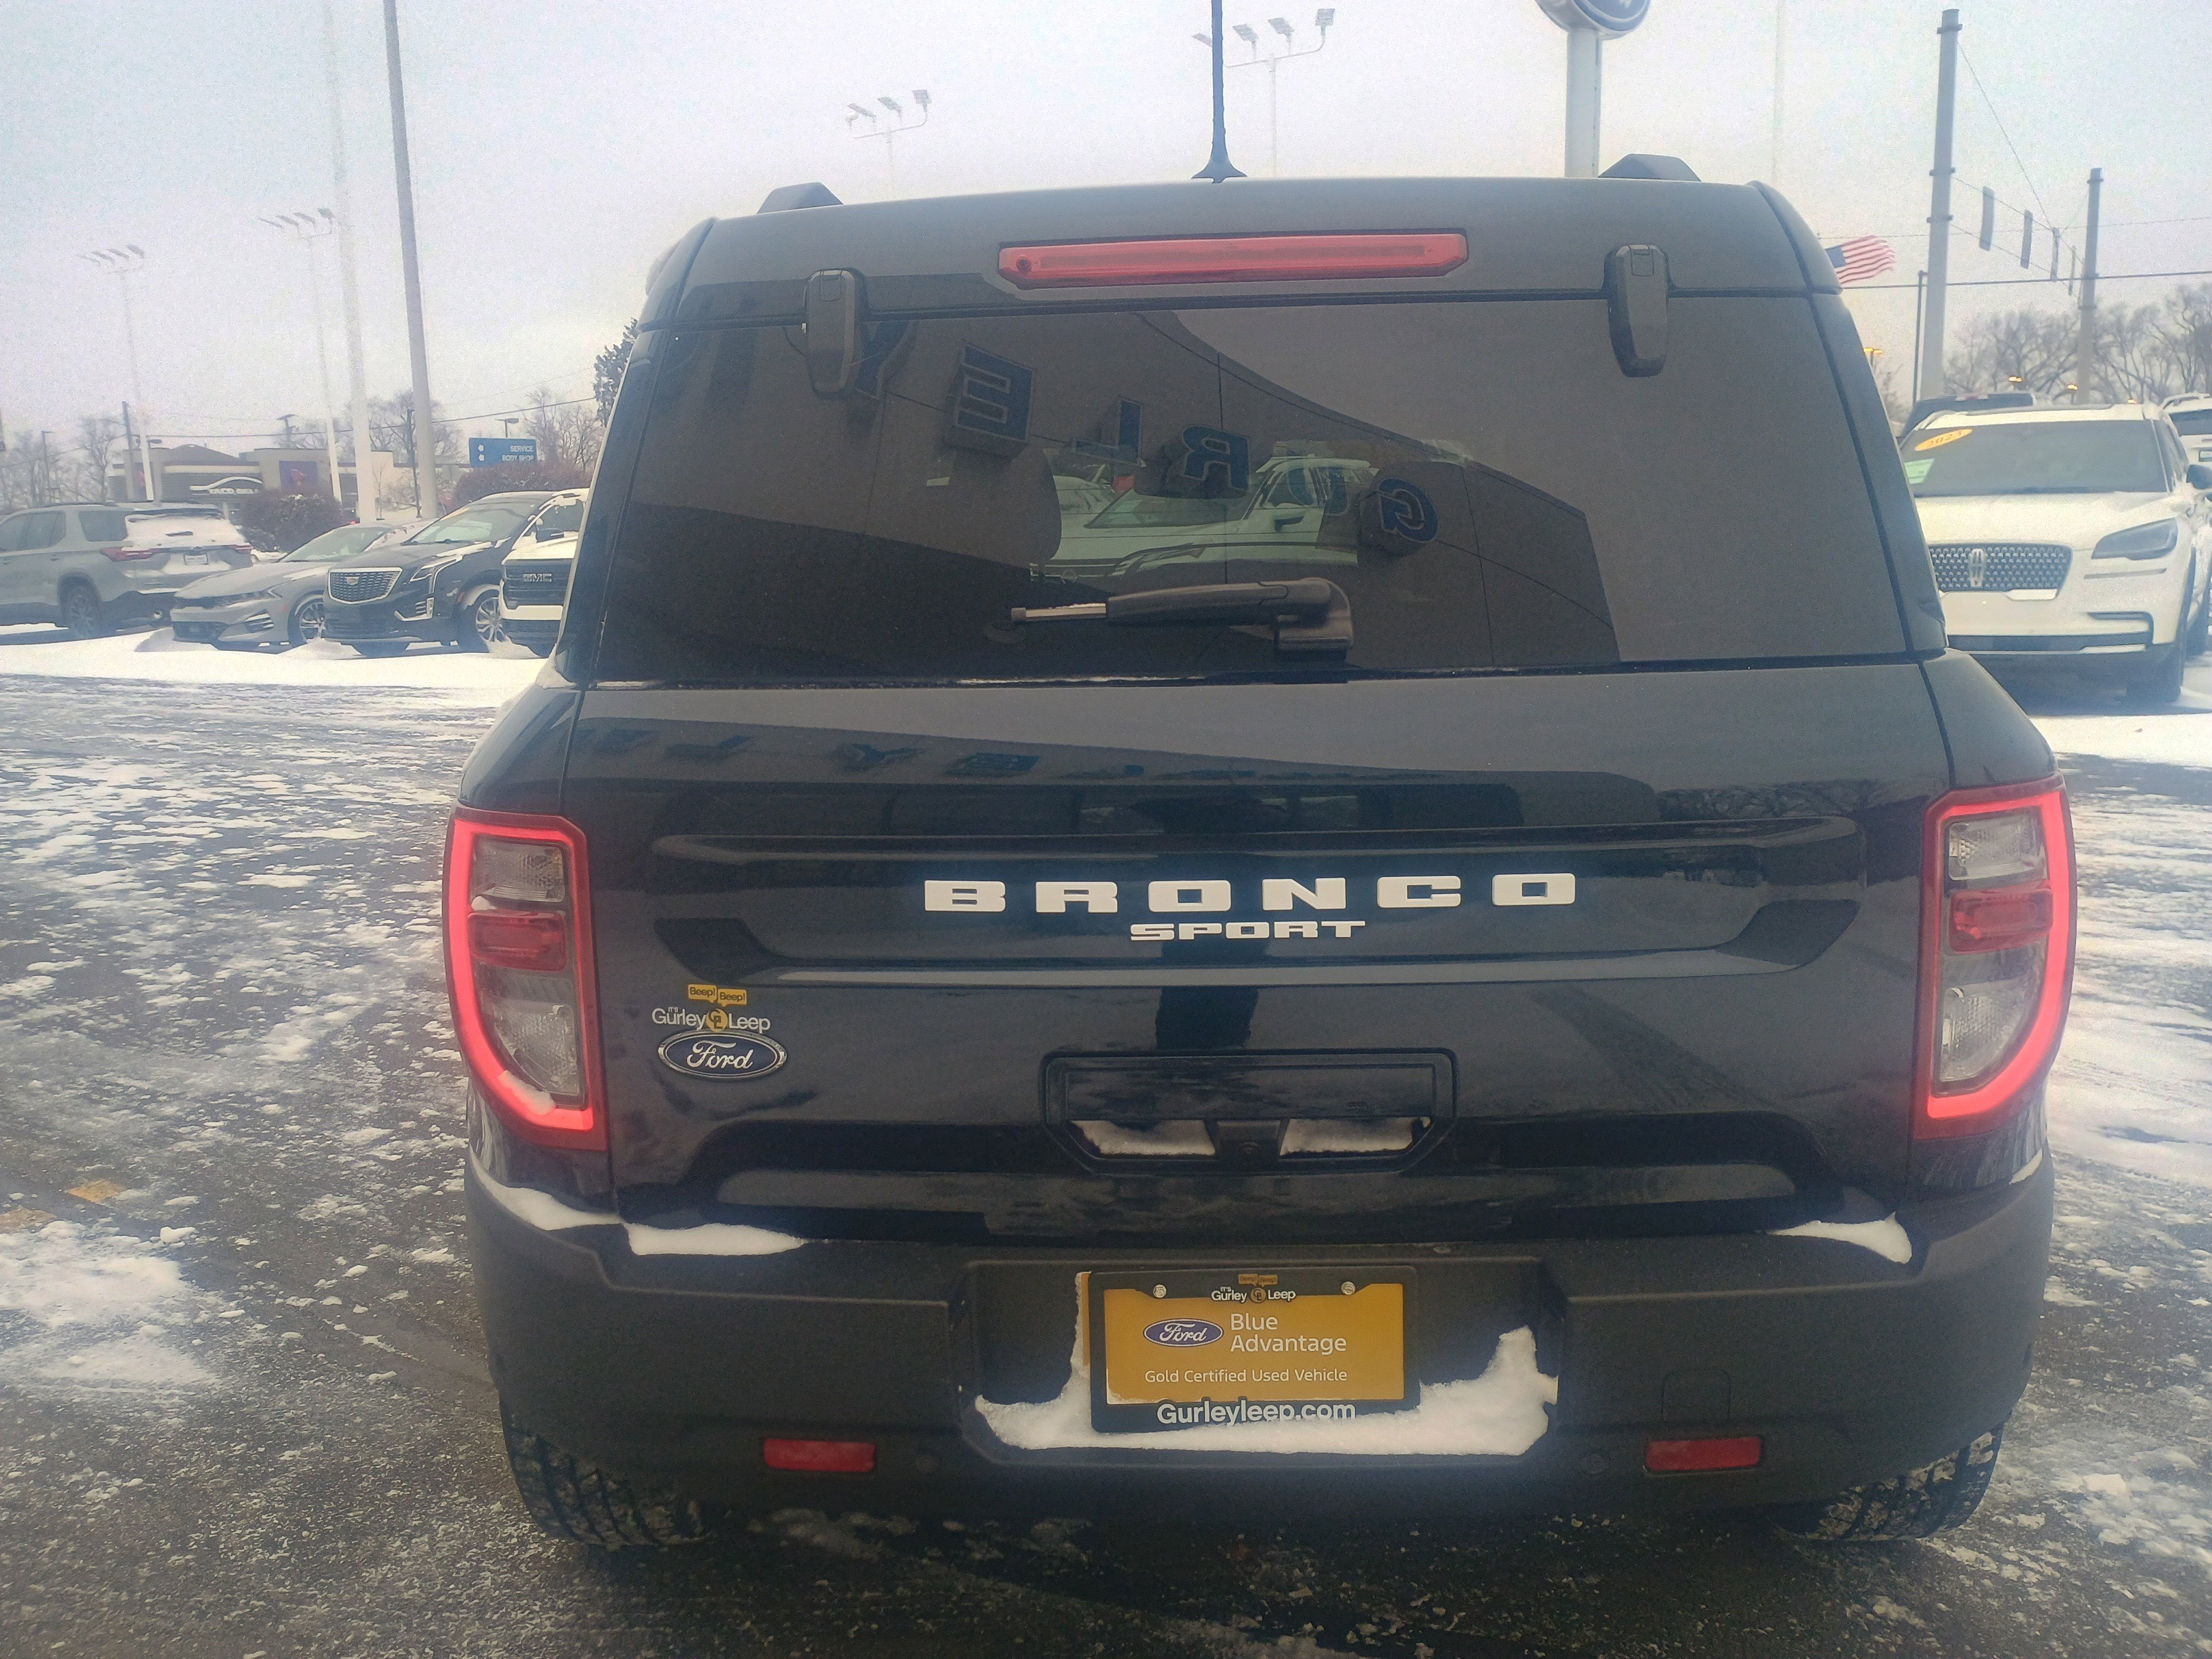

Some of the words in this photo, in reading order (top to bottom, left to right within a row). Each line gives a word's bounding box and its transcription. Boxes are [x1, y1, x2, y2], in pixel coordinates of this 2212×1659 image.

[522, 574, 552, 582] GMC
[924, 873, 1576, 913] BRONCO
[1130, 920, 1366, 941] SPORT
[689, 987, 716, 997] Beep!
[719, 992, 745, 1002] Beep!
[651, 1008, 706, 1031] Gurley
[729, 1013, 771, 1034] Leep
[686, 1040, 754, 1069] Ford
[1211, 1290, 1247, 1303] Gurley
[1267, 1290, 1297, 1301] Leep
[1159, 1322, 1208, 1342] Ford
[1230, 1313, 1278, 1331] Blue
[1230, 1334, 1347, 1355] Advantage
[1145, 1370, 1179, 1382] Gold
[1184, 1369, 1246, 1382] Certified
[1252, 1369, 1290, 1382] Used
[1294, 1368, 1347, 1381] Vehicle
[1157, 1400, 1356, 1426] Gurleyleep.com
